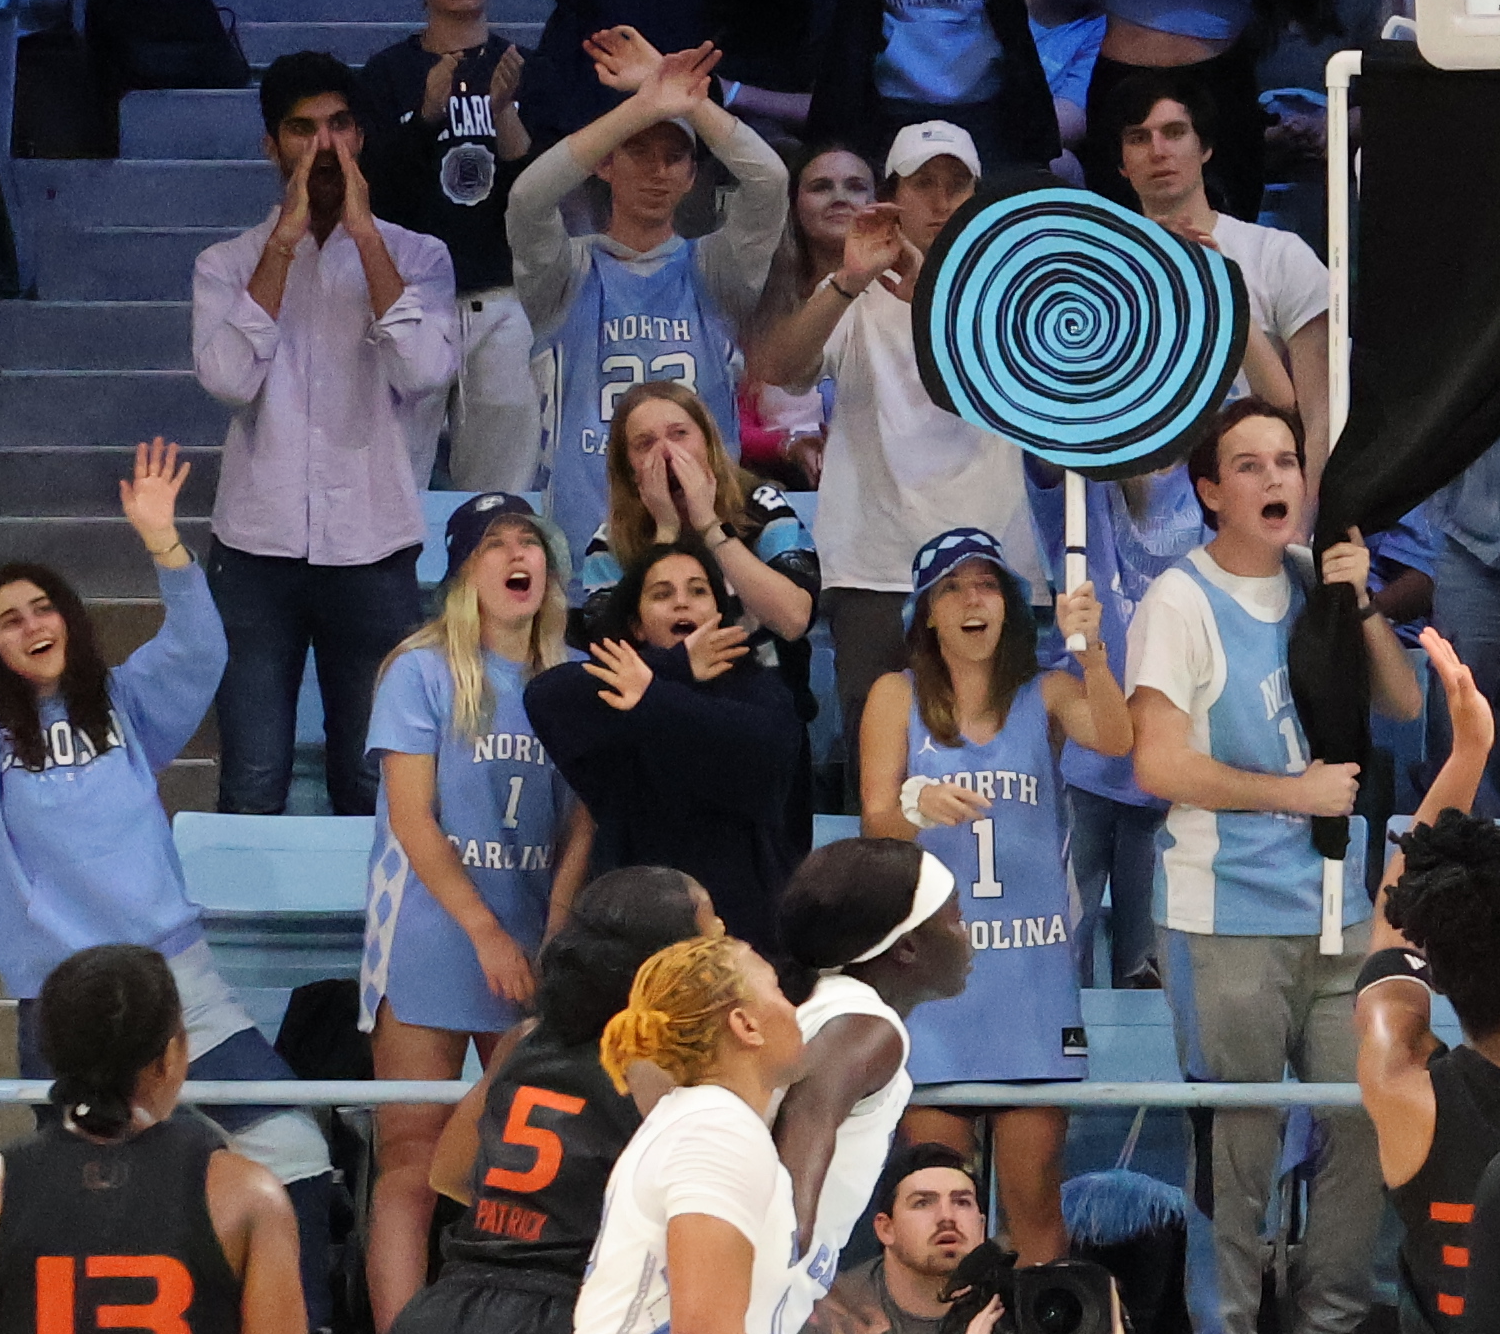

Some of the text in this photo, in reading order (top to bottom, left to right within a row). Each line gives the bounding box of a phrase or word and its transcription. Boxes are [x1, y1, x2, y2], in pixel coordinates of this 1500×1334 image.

[602, 313, 692, 345] NORTH
[472, 732, 547, 765] NORT
[502, 775, 525, 830] 1
[971, 817, 1005, 900] 1
[961, 914, 1068, 951] OLINA
[483, 1083, 587, 1195] 5
[474, 1198, 549, 1242] PATRICK
